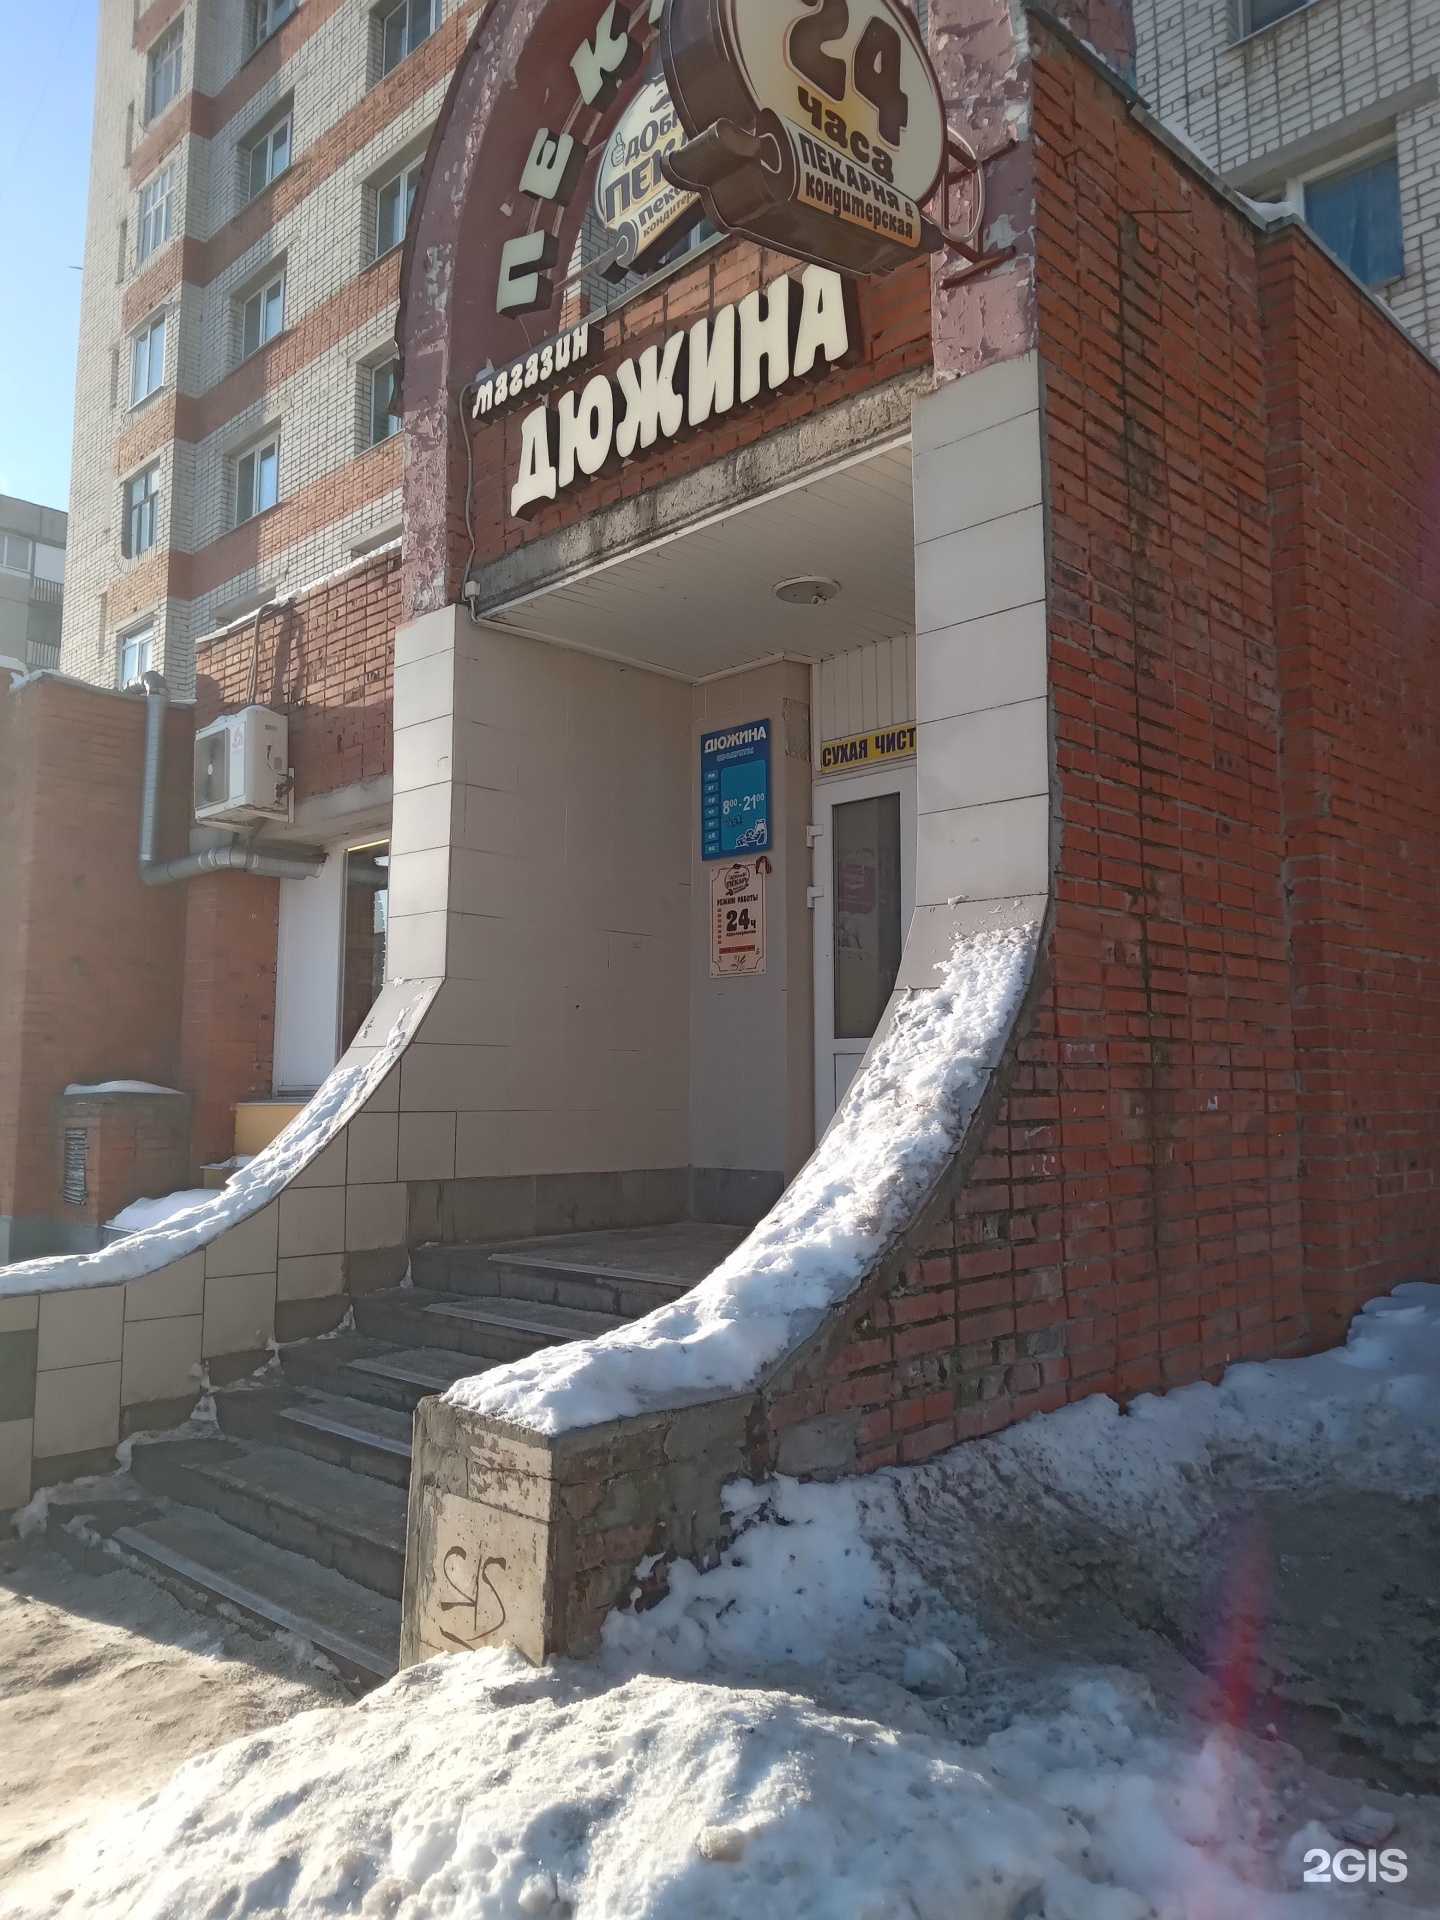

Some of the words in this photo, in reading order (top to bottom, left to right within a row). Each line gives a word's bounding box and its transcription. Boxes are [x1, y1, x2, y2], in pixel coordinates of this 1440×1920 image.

[789, 0, 908, 147] 24
[497, 0, 665, 314] ПЕК
[798, 132, 899, 212] ПЕКАРНЯ
[805, 172, 913, 239] кондитерская
[472, 322, 589, 419] магазин
[511, 263, 848, 518] ДЮЖИНА
[704, 726, 767, 753] ДЮЖИНА
[822, 738, 868, 767] СУХАЯ
